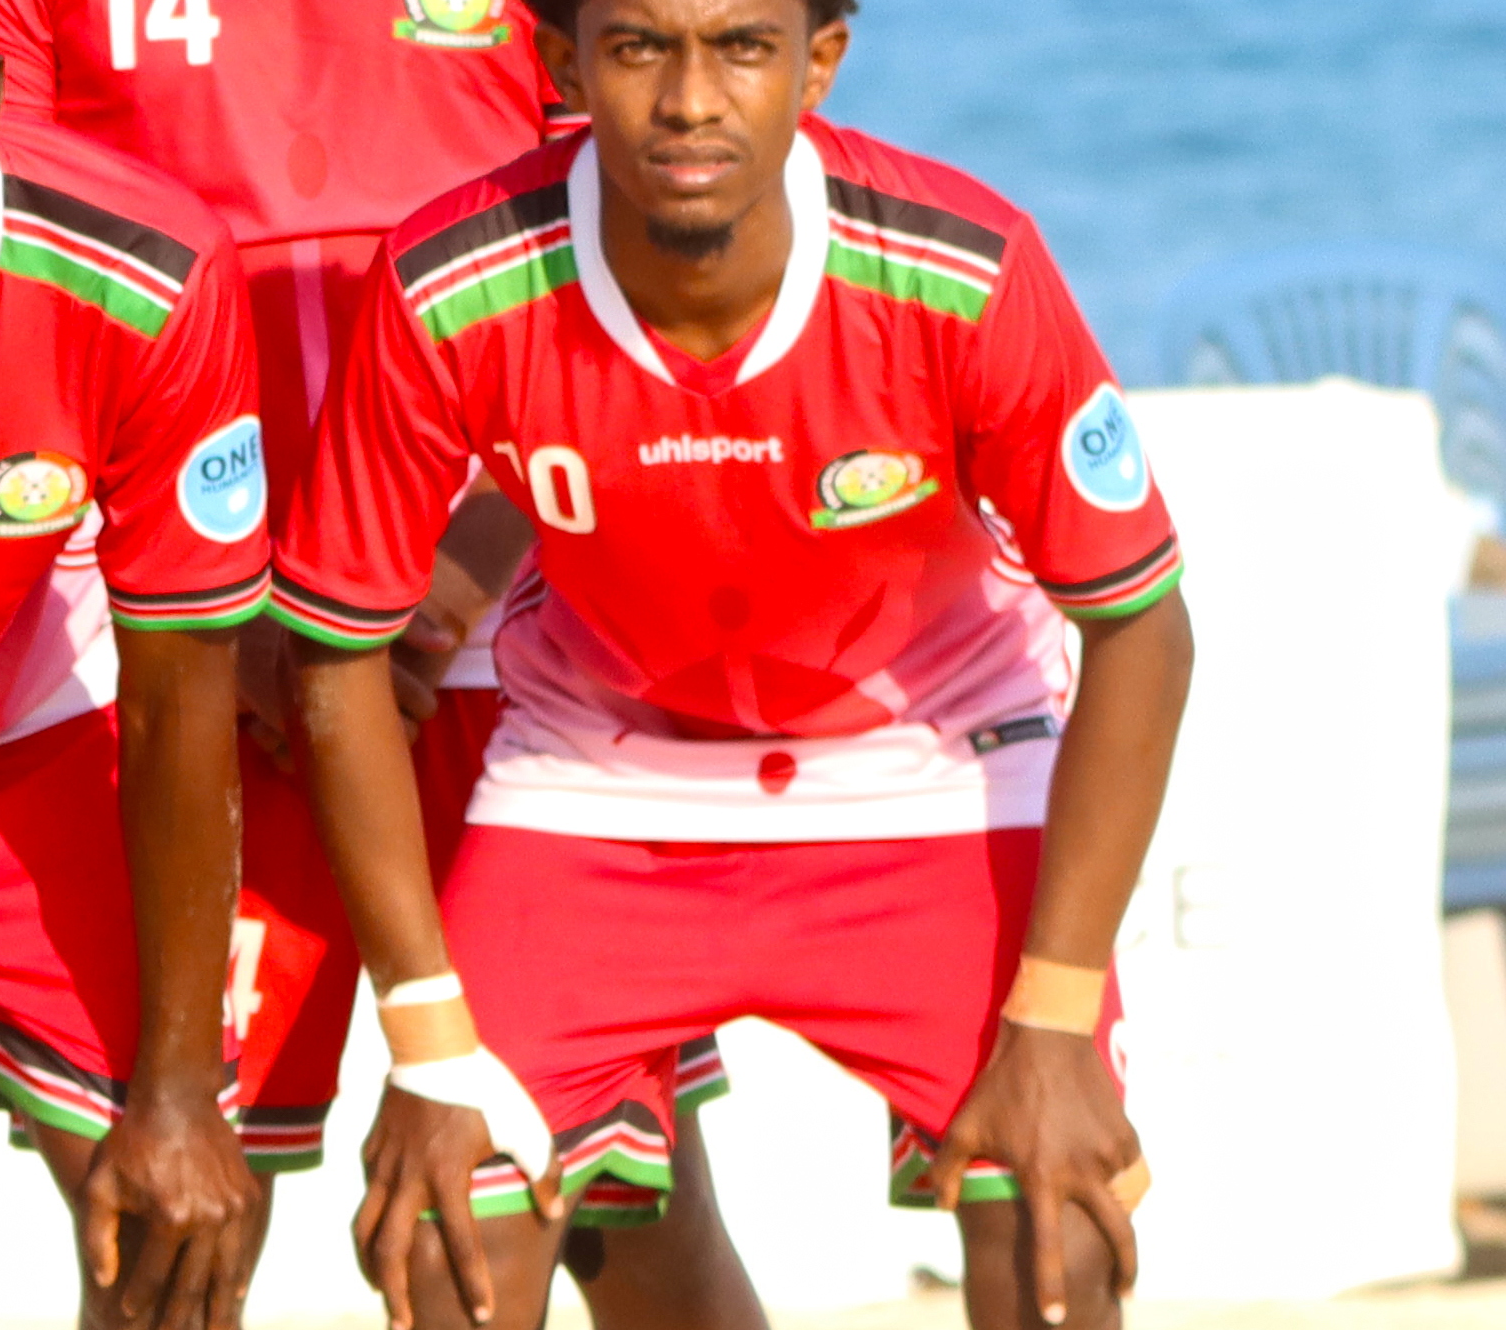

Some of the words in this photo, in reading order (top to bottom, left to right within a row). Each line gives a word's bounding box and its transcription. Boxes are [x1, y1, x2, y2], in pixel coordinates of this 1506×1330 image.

[201, 434, 258, 482] ONE
[638, 434, 785, 466] uhlsport
[222, 917, 266, 1040] 4
